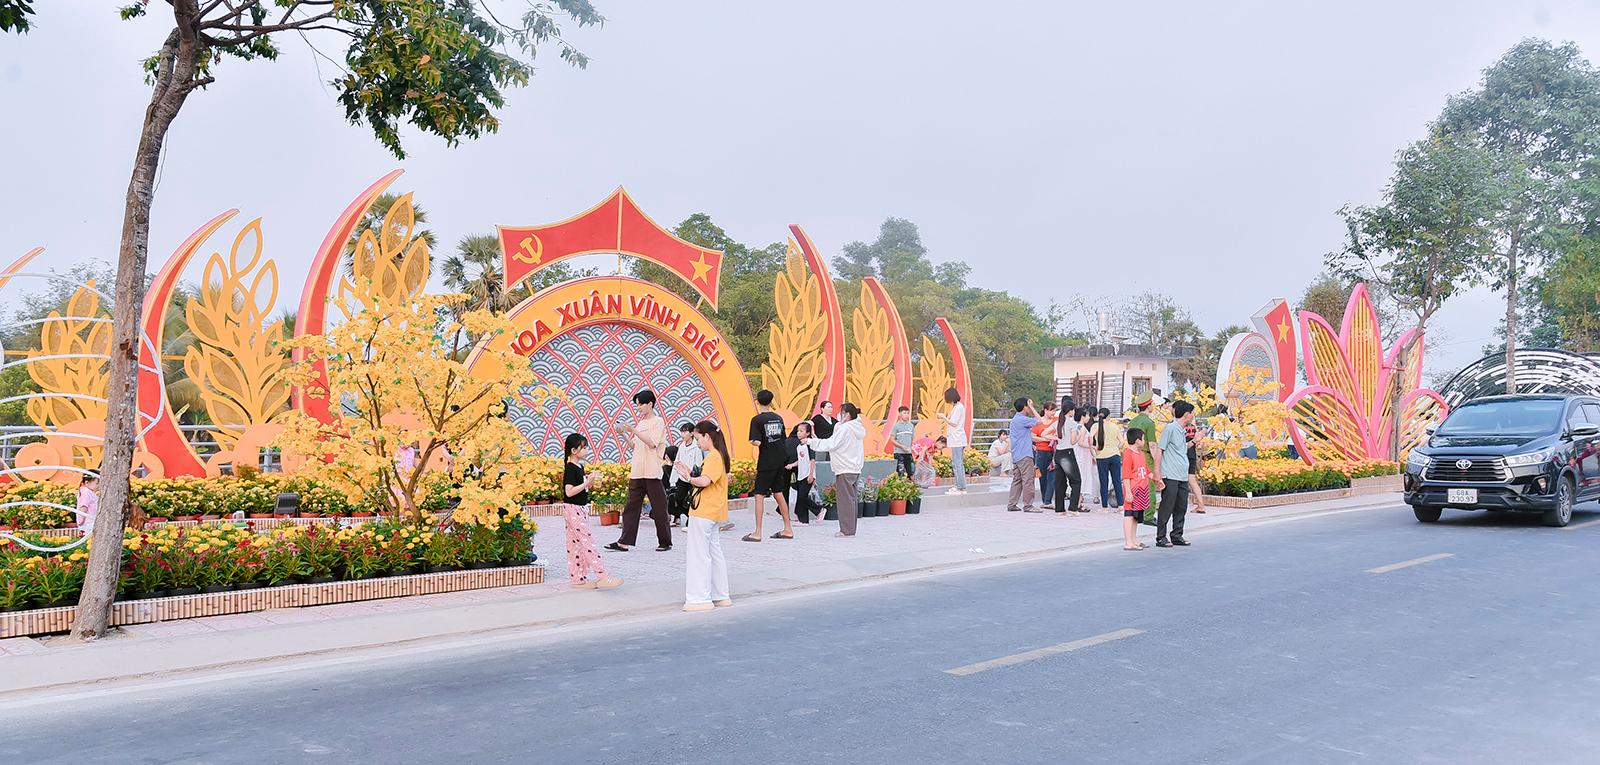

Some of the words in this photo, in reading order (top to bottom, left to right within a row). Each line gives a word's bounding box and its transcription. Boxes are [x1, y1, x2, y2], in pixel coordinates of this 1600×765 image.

[554, 290, 622, 327] XUÂN
[628, 293, 681, 331] VĨNH
[680, 321, 725, 371] ĐIỀU
